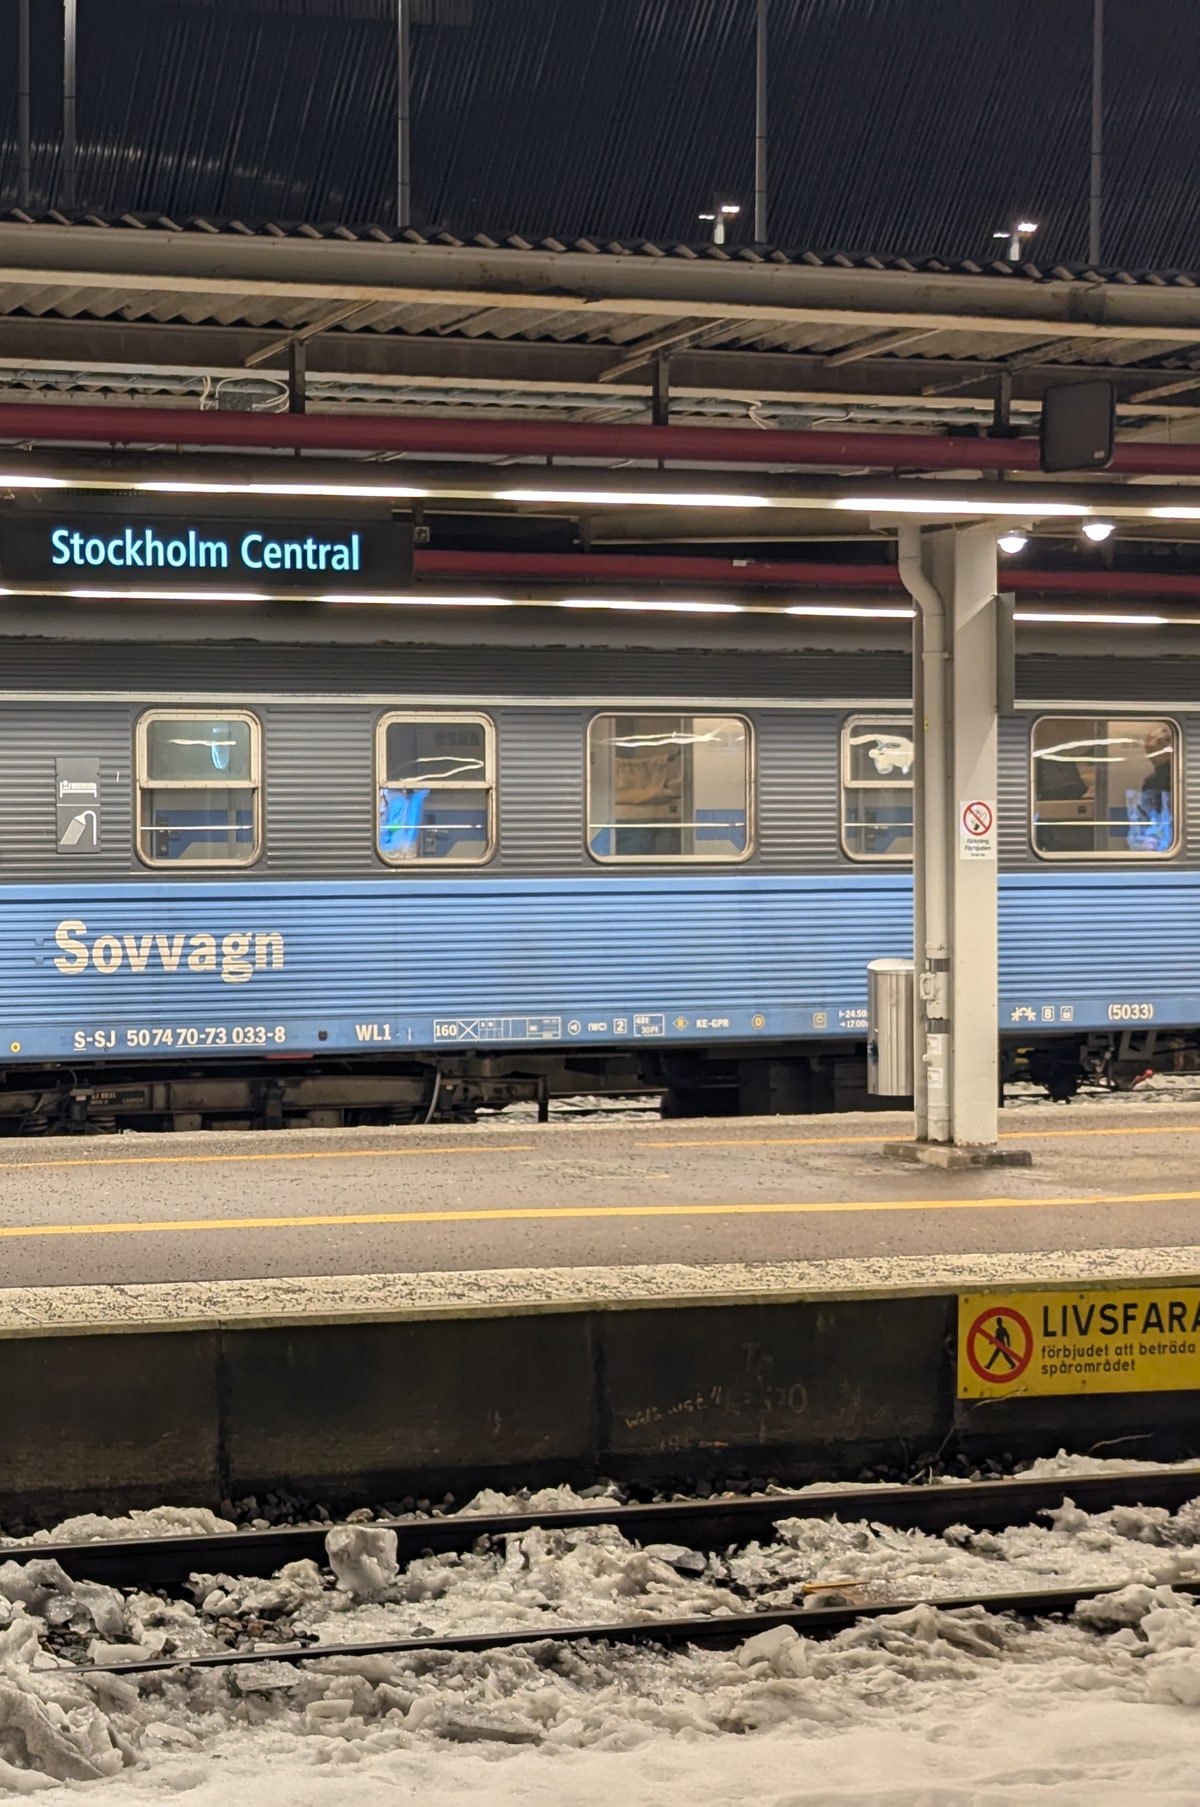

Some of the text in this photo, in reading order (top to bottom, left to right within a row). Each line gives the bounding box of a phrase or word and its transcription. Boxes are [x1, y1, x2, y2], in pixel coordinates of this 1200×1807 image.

[51, 529, 361, 571] Stockholm Central
[54, 919, 285, 983] Sovvagn
[1108, 1003, 1154, 1020] (5033)
[355, 1024, 392, 1041] WL1
[435, 1024, 457, 1036] 160
[616, 1021, 624, 1031] 2
[73, 1030, 116, 1049] S-SJ
[232, 1026, 286, 1044] 033-8
[1041, 1339, 1196, 1360] förbjudet att beträda
[1041, 1359, 1135, 1377] spårområdet
